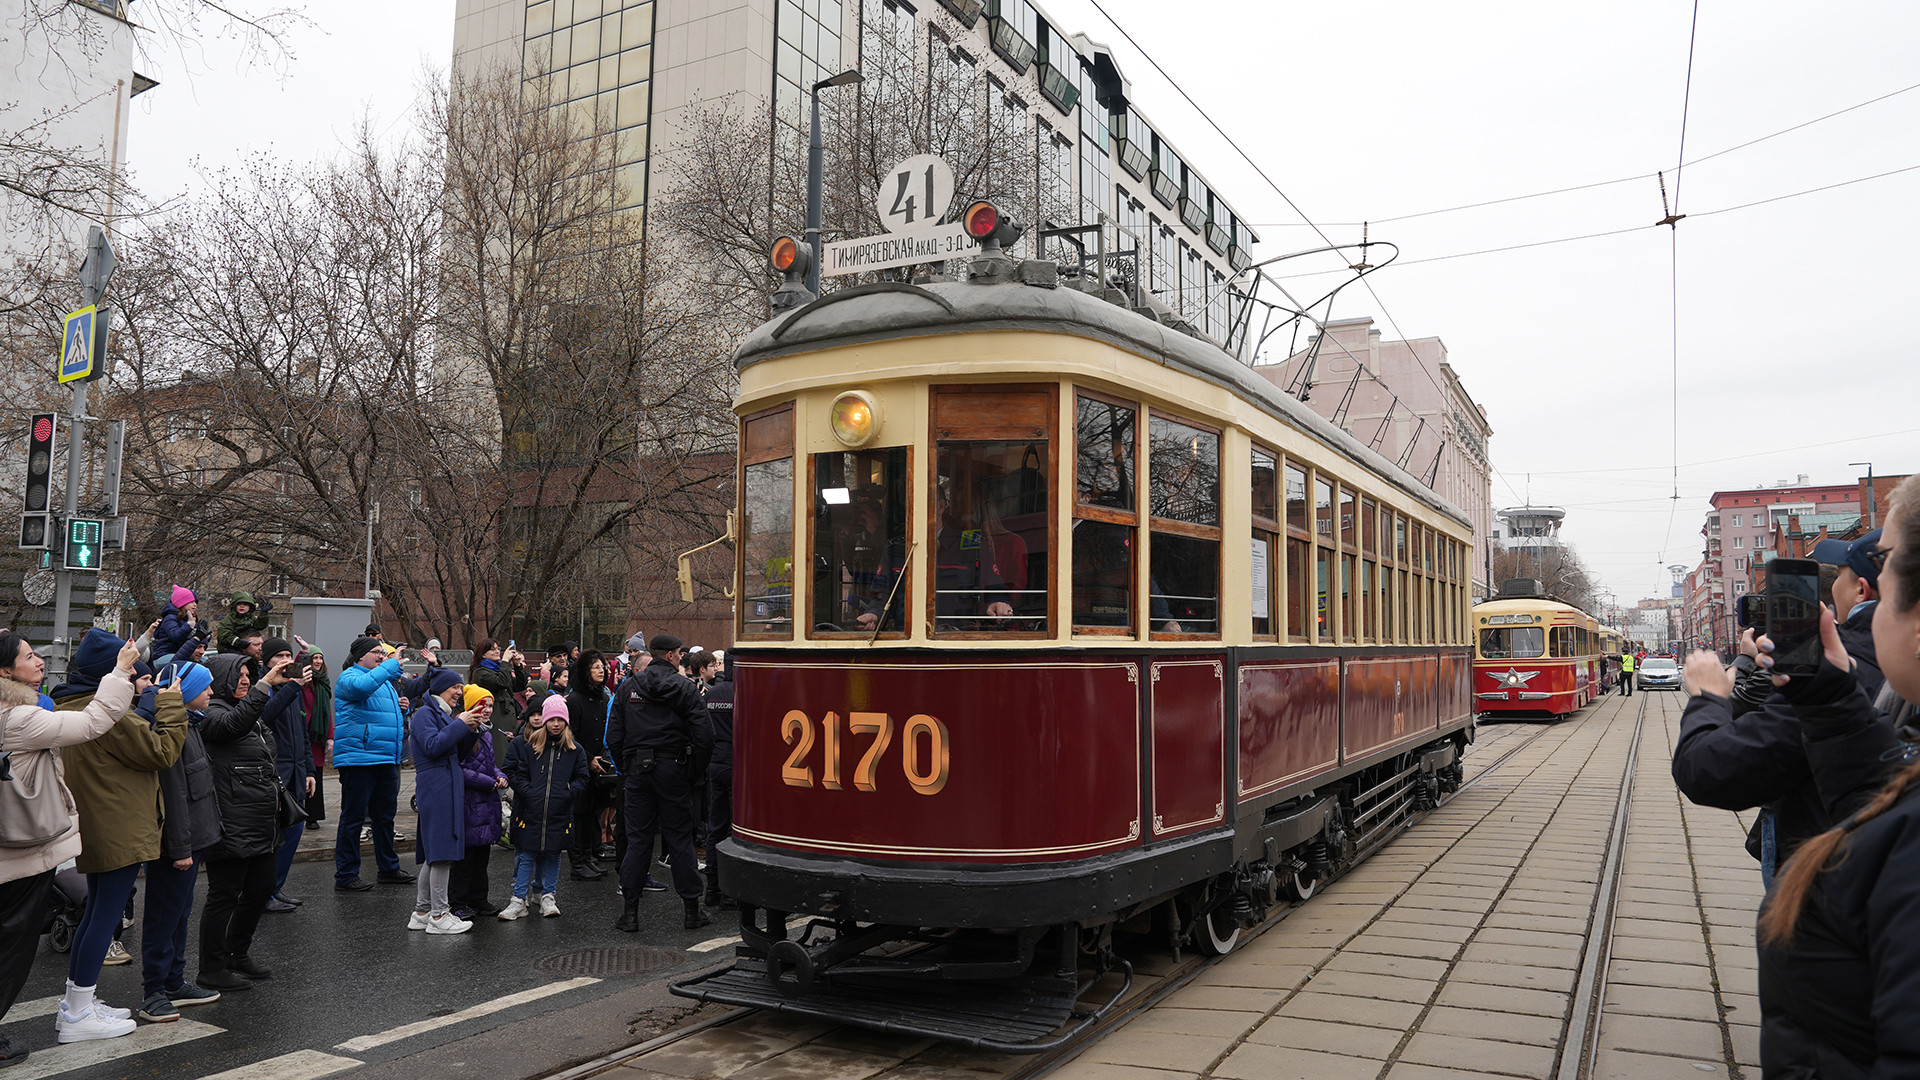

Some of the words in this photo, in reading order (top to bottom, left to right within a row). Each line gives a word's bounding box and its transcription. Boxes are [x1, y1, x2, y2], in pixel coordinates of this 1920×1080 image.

[888, 164, 936, 224] 41
[831, 236, 914, 269] ТИМИРЯЗЕВСКАЯ
[781, 709, 950, 795] 2170
